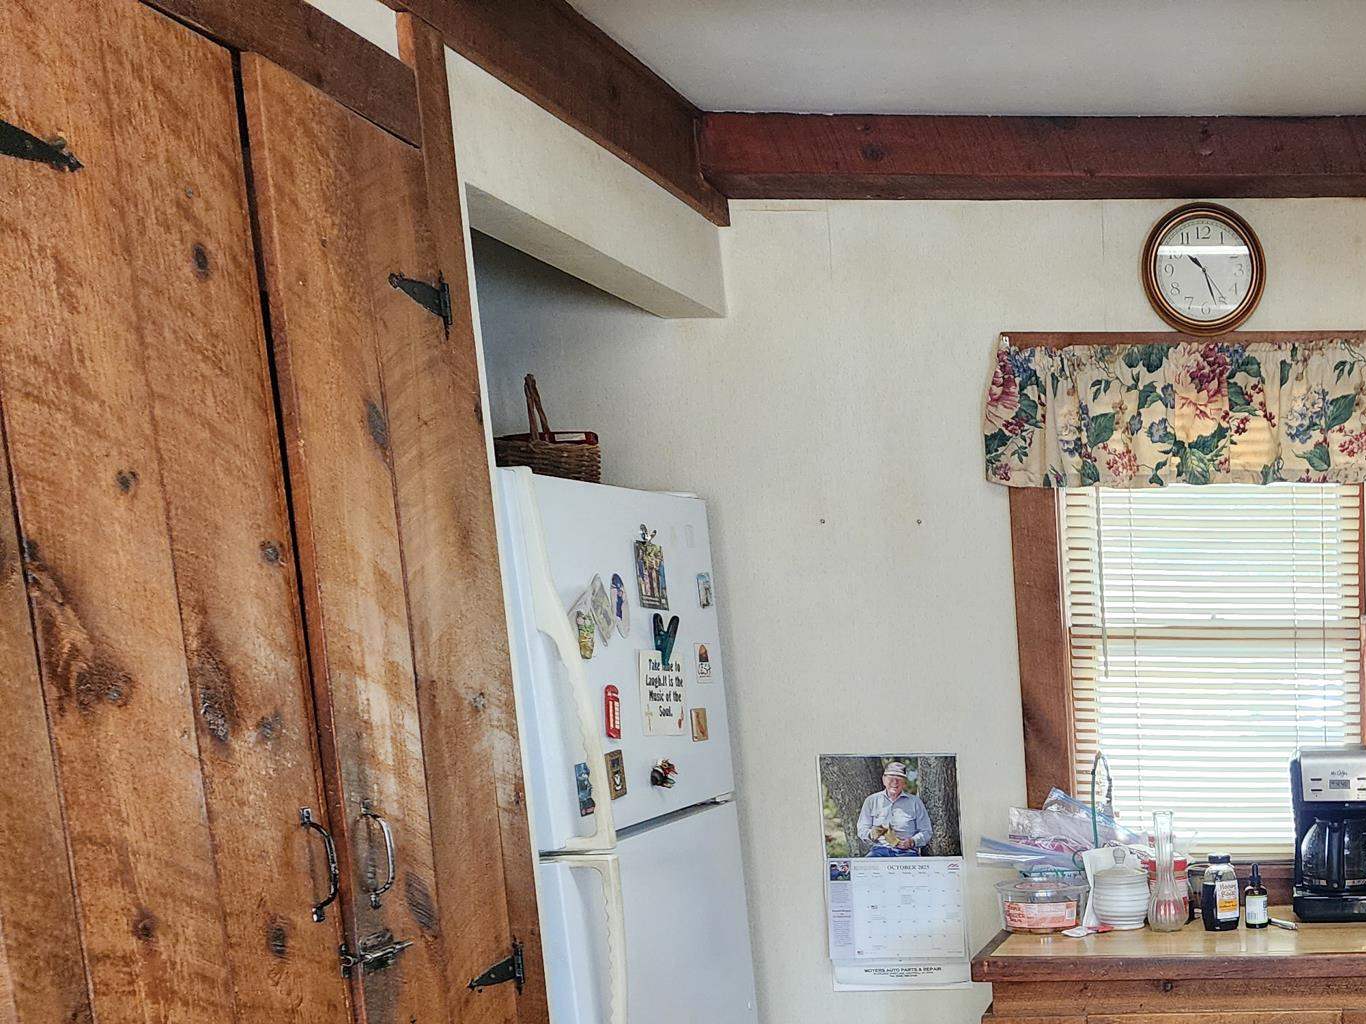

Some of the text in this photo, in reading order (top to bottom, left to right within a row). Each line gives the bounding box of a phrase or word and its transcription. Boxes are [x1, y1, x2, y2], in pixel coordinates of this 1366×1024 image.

[1180, 232, 1190, 245] 11
[1195, 225, 1211, 240] 12
[1164, 264, 1175, 277] 9
[1234, 263, 1244, 277] 3
[1170, 282, 1181, 296] 8
[1229, 282, 1238, 295] 4
[1184, 296, 1194, 310] 7
[1201, 302, 1211, 315] 6
[648, 659, 660, 672] Take
[668, 675, 673, 686] is
[675, 676, 683, 687] the
[649, 690, 681, 702] Music of the
[659, 705, 673, 717] Soul.
